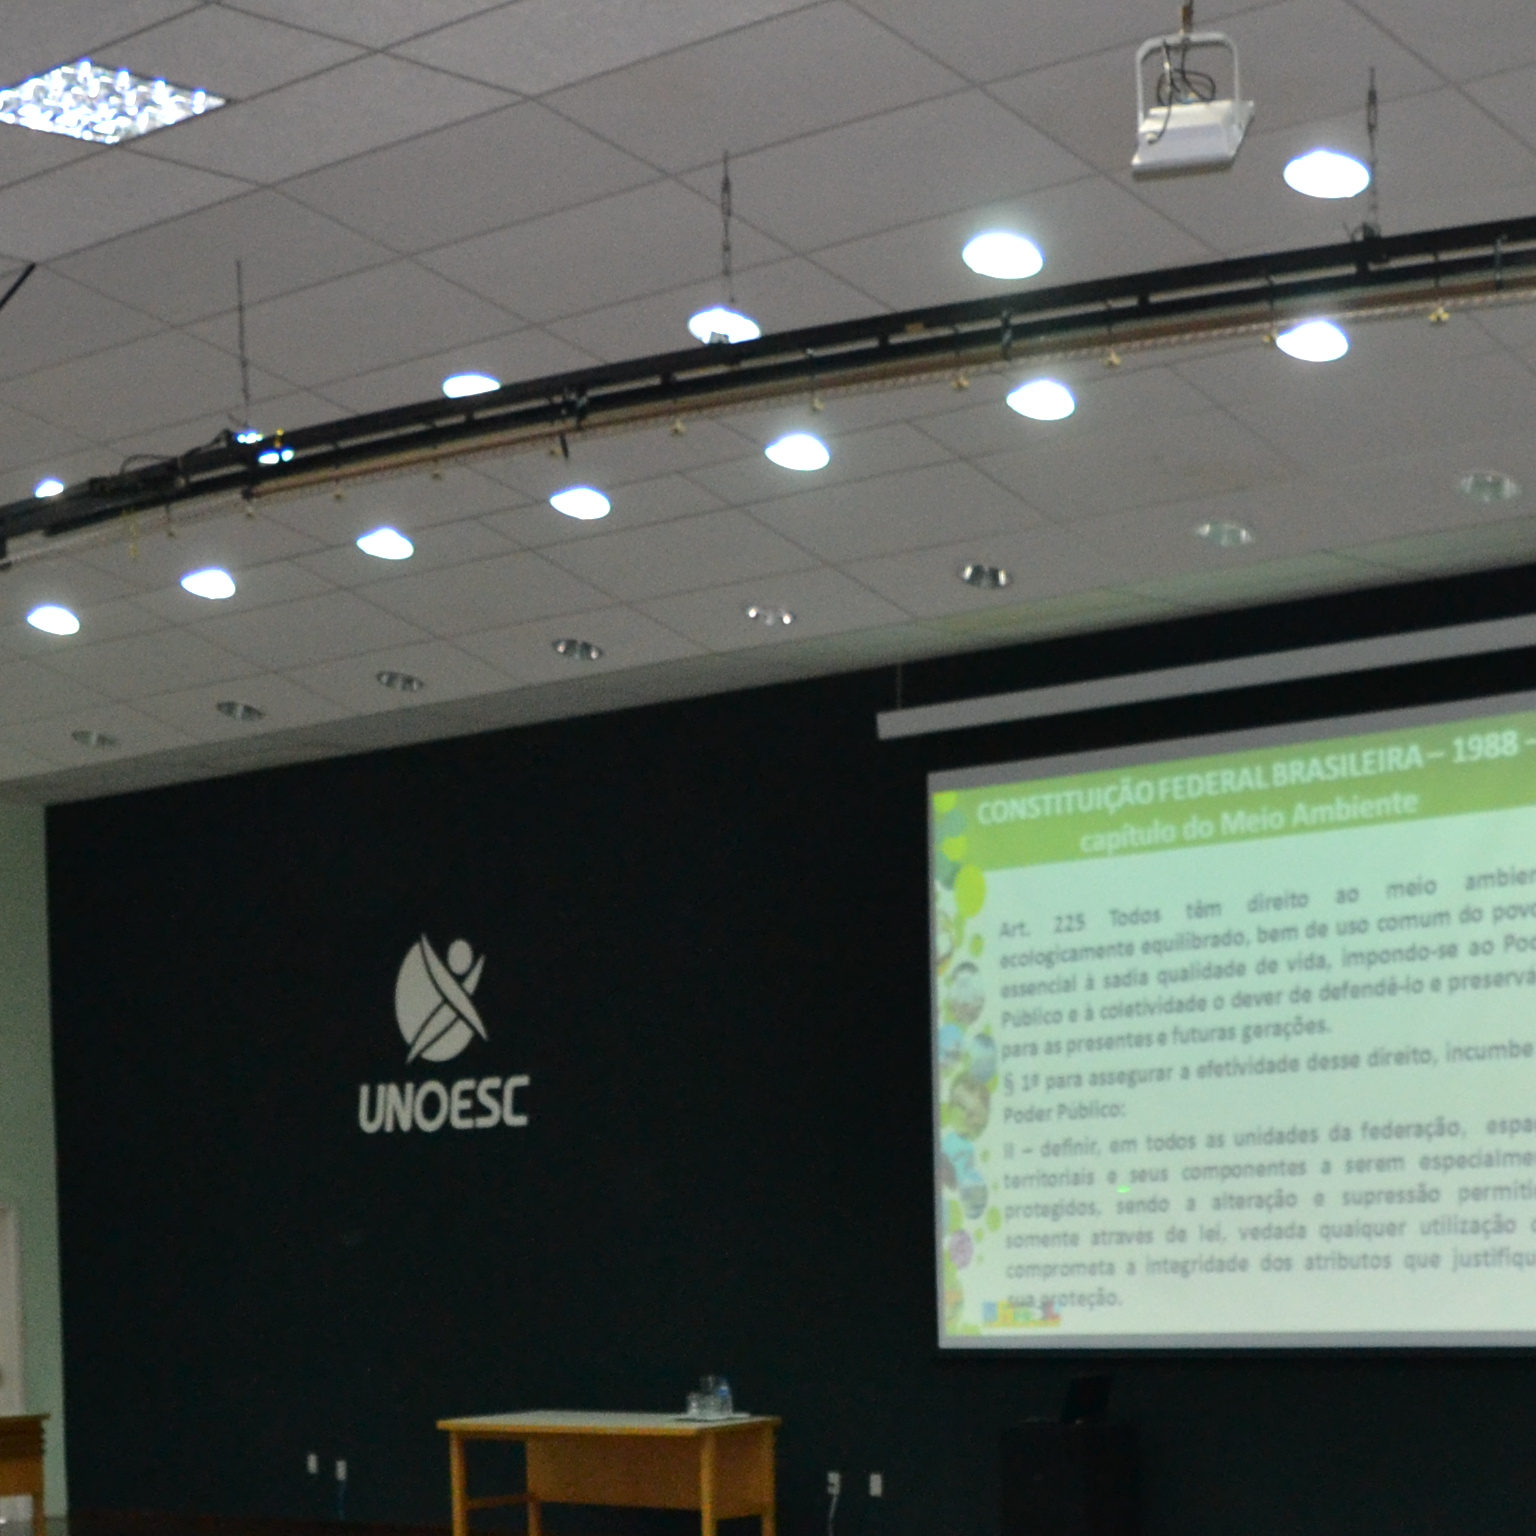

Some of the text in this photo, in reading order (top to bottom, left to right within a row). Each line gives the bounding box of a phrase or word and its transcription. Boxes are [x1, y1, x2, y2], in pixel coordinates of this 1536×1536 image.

[977, 776, 1154, 825] CONSTITUIÇÃO
[1157, 764, 1265, 802] FEDERAL
[1272, 744, 1424, 787] BRASILEIRA
[1452, 730, 1519, 764] 1988
[1080, 791, 1420, 854] capítulo do Meio Ambiente
[999, 921, 1031, 938] Art.
[1054, 914, 1085, 933] 225
[1109, 907, 1161, 927] Todos
[1247, 890, 1309, 914] direito
[1336, 887, 1359, 904] ao
[1386, 875, 1437, 899] meio
[1000, 941, 1134, 969] ecologicamente
[1141, 930, 1251, 956] equilibrado,
[1257, 924, 1298, 944] bem
[1305, 921, 1328, 939] de
[1336, 919, 1368, 935] uso
[1377, 910, 1451, 932] comum
[1459, 906, 1483, 924] do
[1000, 976, 1076, 999] essencial
[1103, 970, 1148, 988] sadia
[1157, 961, 1246, 987] qualidade
[1256, 959, 1278, 975] de
[1286, 953, 1331, 973] vida,
[1341, 942, 1458, 970] impondo-se
[1468, 939, 1494, 957] ao
[1069, 1009, 1078, 1023] e
[1100, 994, 1206, 1019] coletividade
[1213, 995, 1224, 1009] o
[1231, 988, 1282, 1008] dever
[1288, 985, 1311, 1004] de
[1319, 974, 1423, 1001] defendê-lo
[1430, 977, 1441, 992] e
[1002, 1015, 1332, 1061] para as presentes e futuras gerações.
[1046, 1072, 1082, 1091] para
[1089, 1065, 1172, 1089] assegurar
[1180, 1065, 1190, 1079] a
[1197, 1054, 1300, 1079] efetividade
[1307, 1051, 1360, 1071] desse
[1367, 1045, 1438, 1068] direito,
[1446, 1039, 1533, 1063] incumbe
[359, 1074, 531, 1134] UNOESC
[1004, 1105, 1053, 1124] Poder
[1109, 1138, 1137, 1154] em
[1146, 1133, 1196, 1152] todos
[1206, 1133, 1224, 1149] as
[1233, 1124, 1319, 1147] unidades
[1328, 1124, 1351, 1142] da
[1004, 1168, 1095, 1189] territoriais
[1107, 1170, 1118, 1184] e
[1129, 1168, 1169, 1184] seus
[1181, 1159, 1306, 1182] componentes
[1320, 1159, 1331, 1174] a
[1345, 1155, 1406, 1173] serem
[1116, 1197, 1169, 1215] sendo
[1186, 1197, 1196, 1211] a
[1211, 1188, 1297, 1213] alteração
[1315, 1191, 1325, 1206] e
[1342, 1182, 1441, 1207] supressão
[1006, 1230, 1079, 1249] somente
[1091, 1227, 1153, 1246] através
[1166, 1225, 1187, 1242] de
[1238, 1221, 1307, 1241] vedada
[1319, 1219, 1406, 1243] qualquer
[1420, 1213, 1517, 1239] utilização
[1006, 1260, 1115, 1281] comprometa
[1126, 1261, 1136, 1275] a
[1146, 1254, 1249, 1278] integridade
[1260, 1254, 1293, 1271] dos
[1304, 1250, 1392, 1271] atributos
[1404, 1250, 1441, 1272] que
